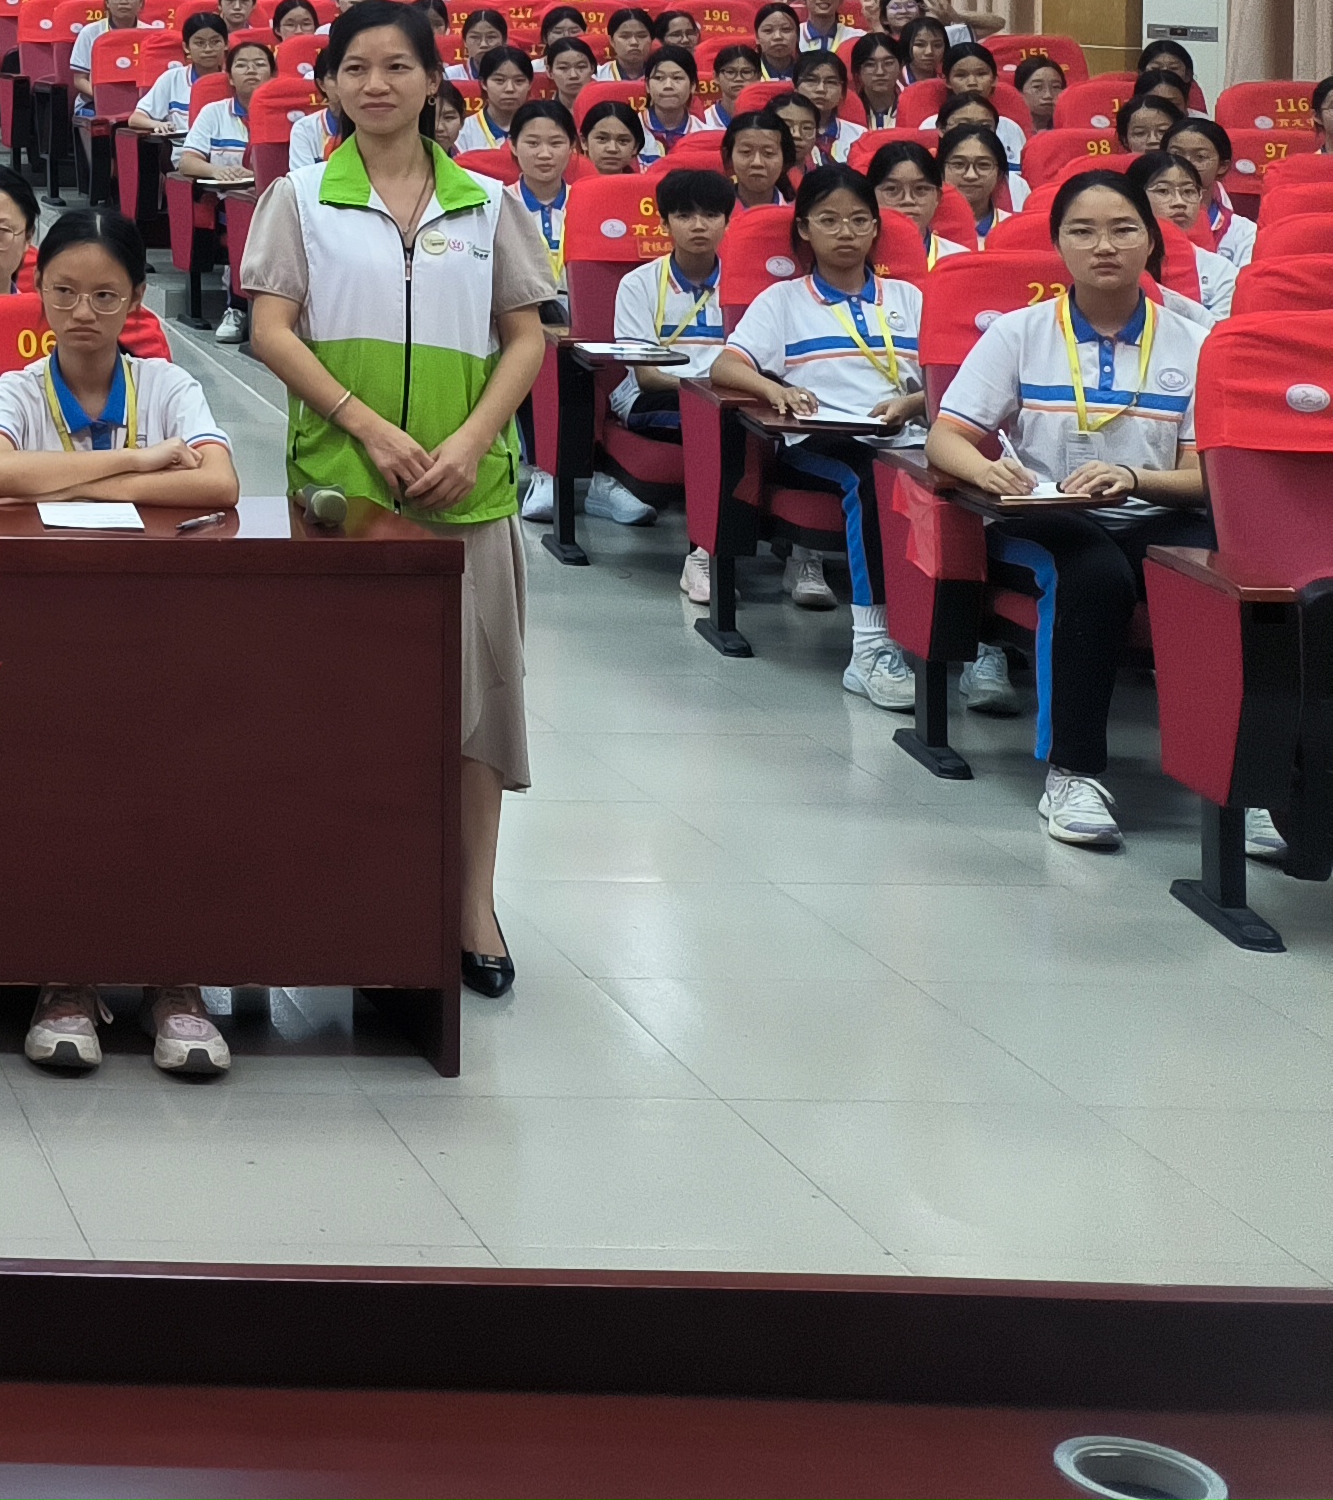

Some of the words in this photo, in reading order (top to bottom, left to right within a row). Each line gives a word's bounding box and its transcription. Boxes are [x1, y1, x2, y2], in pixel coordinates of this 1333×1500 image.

[703, 9, 730, 21] 196
[1274, 97, 1311, 113] 116
[1086, 140, 1112, 156] 98
[1264, 142, 1288, 159] 97
